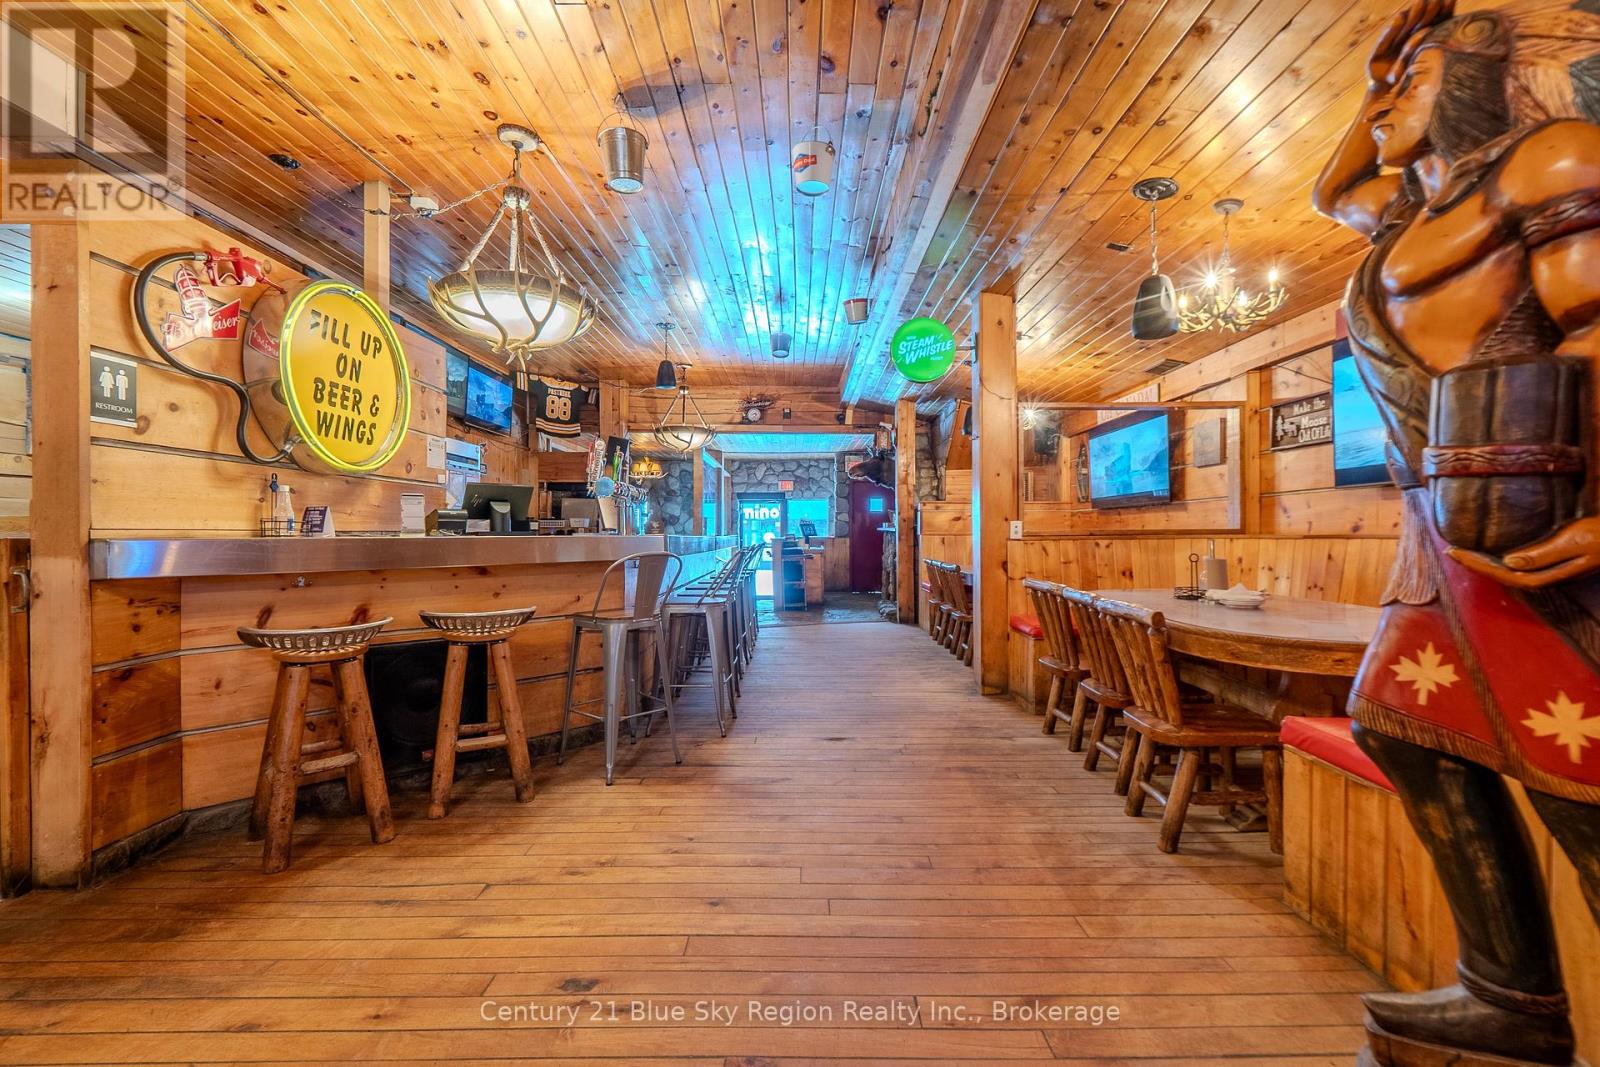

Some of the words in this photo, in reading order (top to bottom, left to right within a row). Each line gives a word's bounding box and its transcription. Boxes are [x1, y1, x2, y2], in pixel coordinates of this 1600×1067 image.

[360, 331, 383, 360] UP
[898, 335, 935, 355] STEAM
[905, 339, 953, 365] WHISTLE
[336, 352, 362, 384] ON
[95, 402, 133, 414] RESTROOM
[313, 377, 363, 416] BEER
[369, 394, 380, 418] &
[545, 394, 572, 421] 88
[316, 409, 377, 446] WINGS
